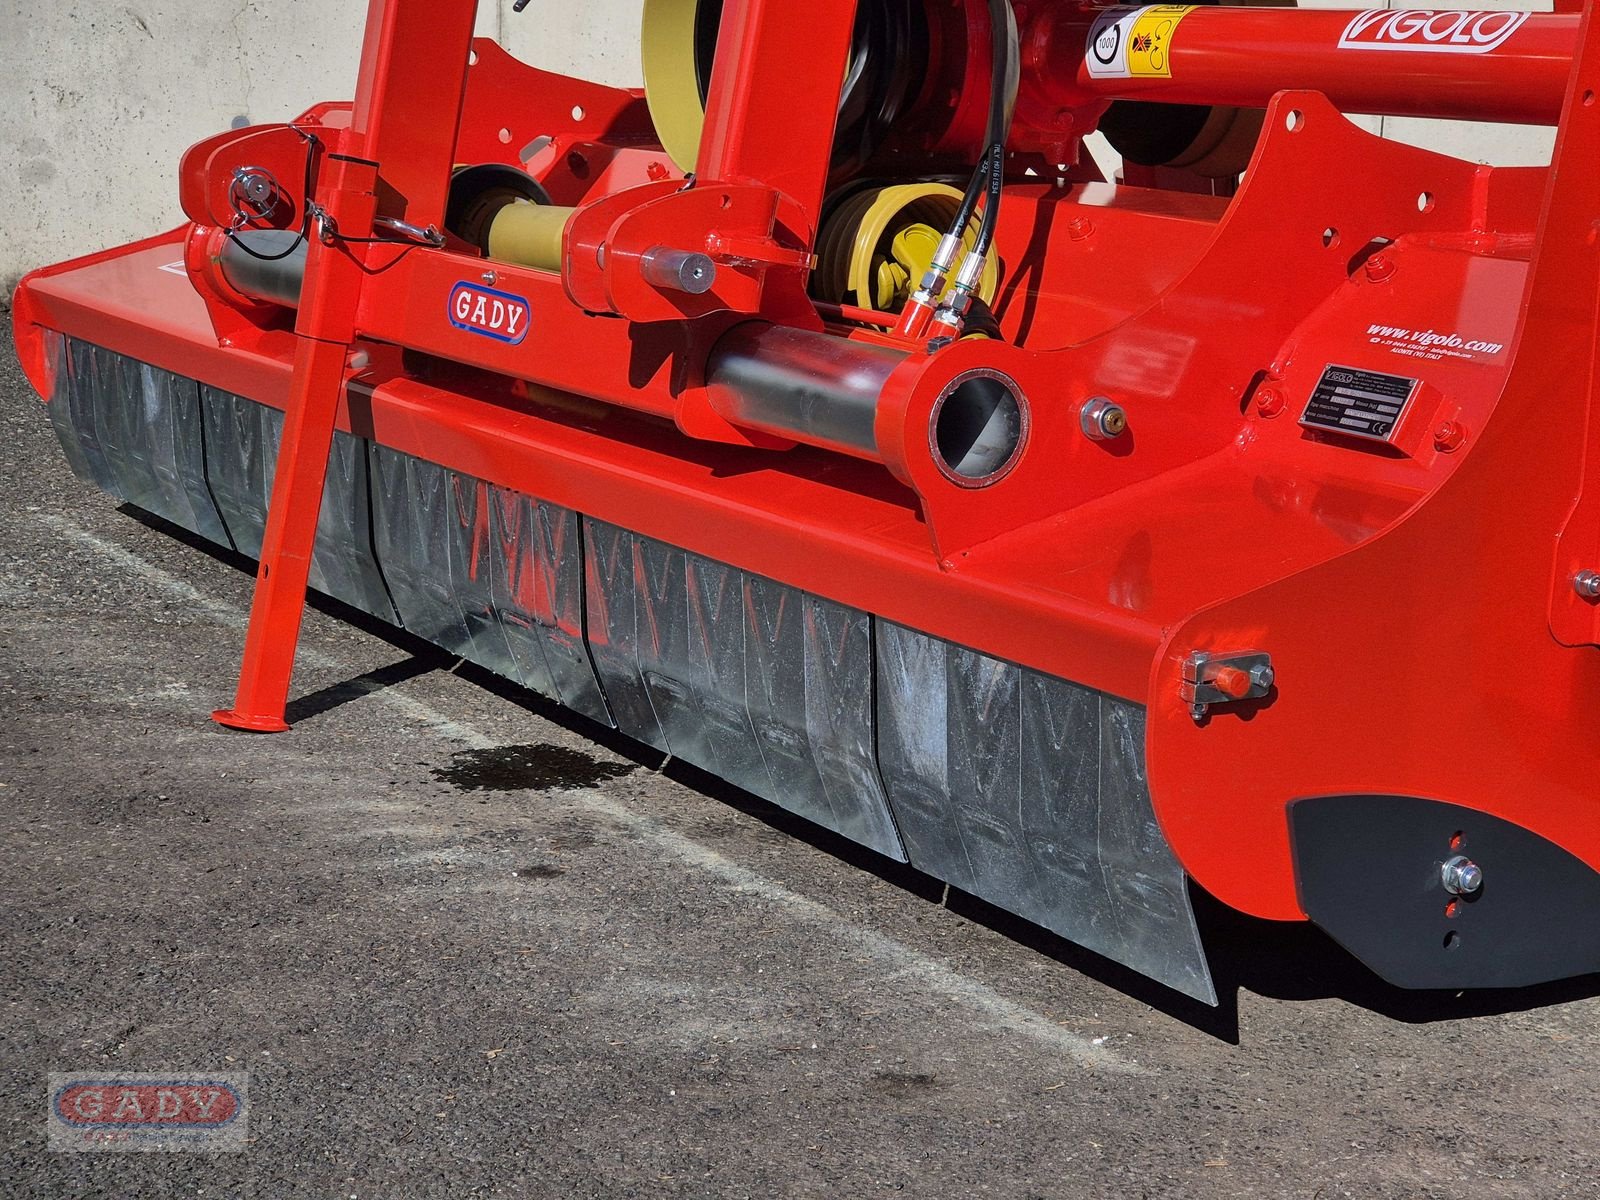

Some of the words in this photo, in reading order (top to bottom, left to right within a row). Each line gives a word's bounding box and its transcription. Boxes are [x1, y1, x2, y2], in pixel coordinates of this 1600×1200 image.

[1344, 9, 1521, 43] VIGOLO
[1099, 37, 1115, 49] 1000
[456, 291, 523, 334] GADY
[1366, 324, 1503, 354] www.vigolo.com
[1424, 352, 1443, 360] ITALY
[1325, 370, 1354, 384] VIGOLO
